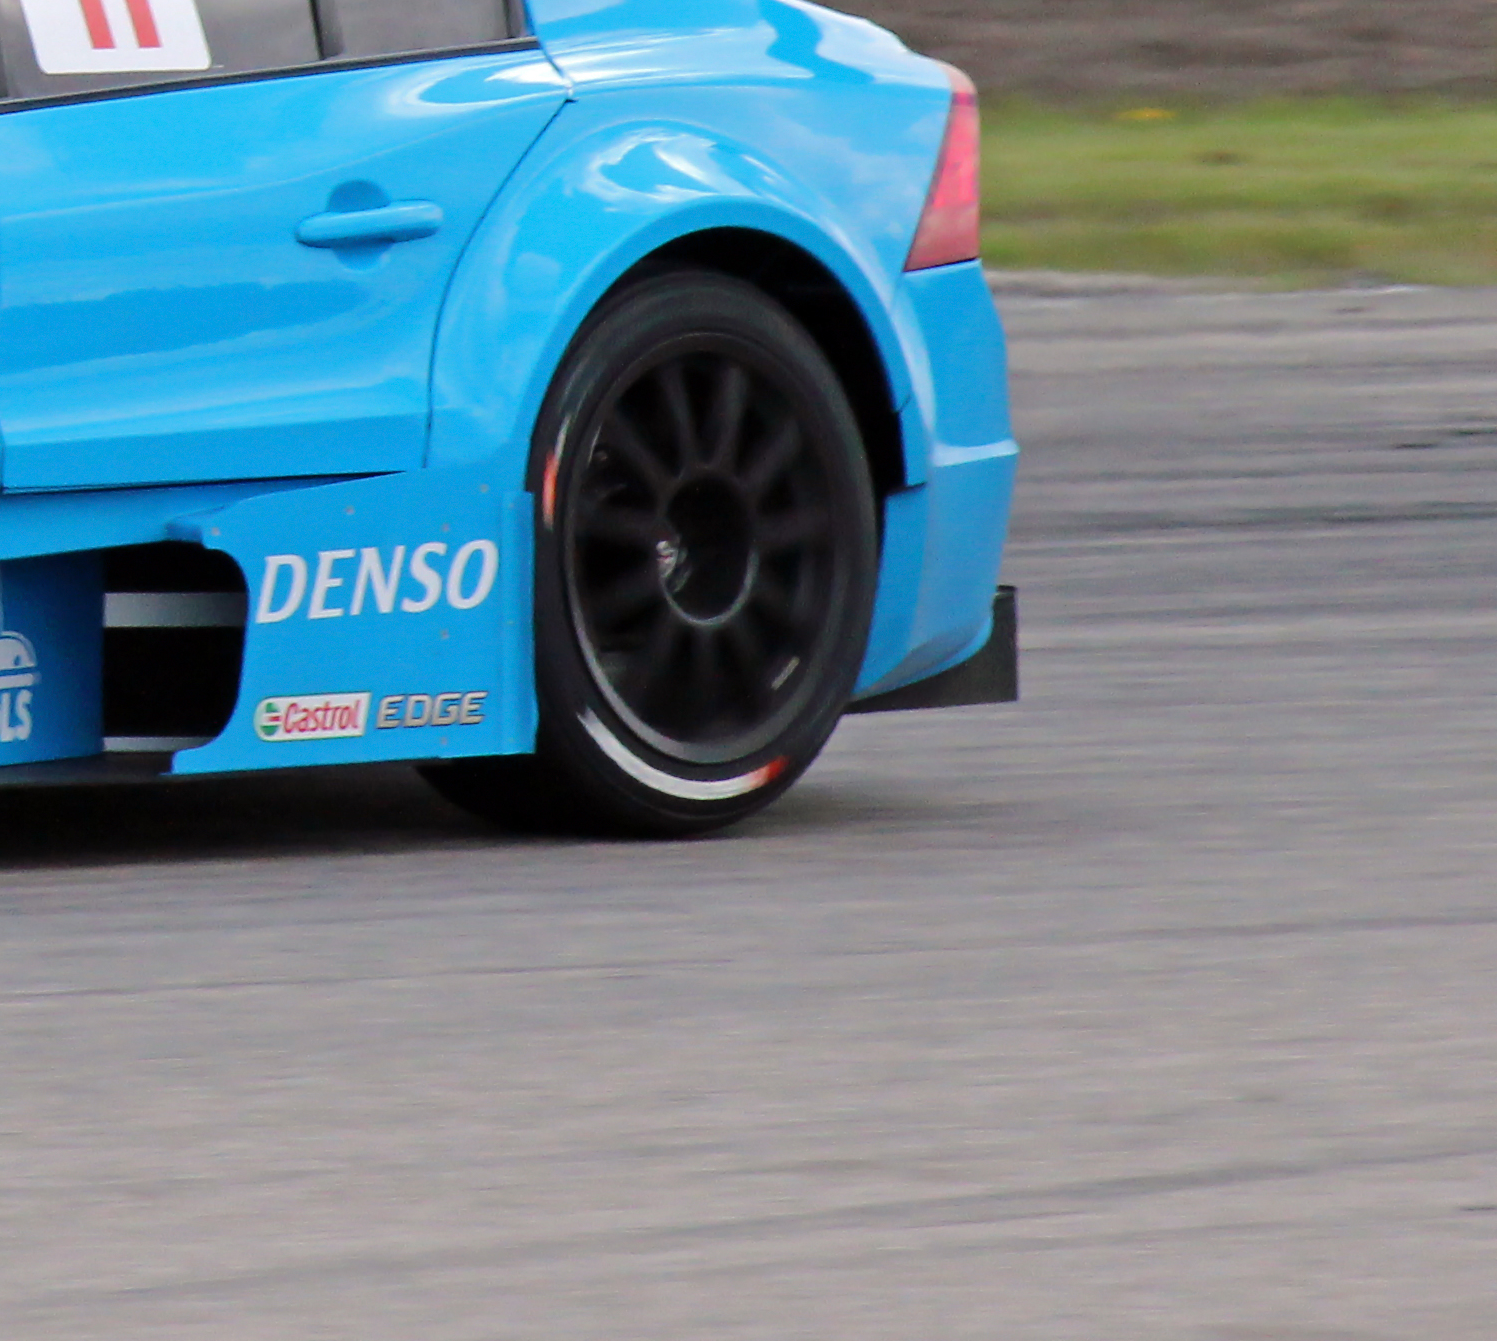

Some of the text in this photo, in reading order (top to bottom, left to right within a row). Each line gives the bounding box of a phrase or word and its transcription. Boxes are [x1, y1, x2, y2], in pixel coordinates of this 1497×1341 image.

[255, 539, 499, 624] DENSO
[282, 691, 488, 734] Castrol EDGE
